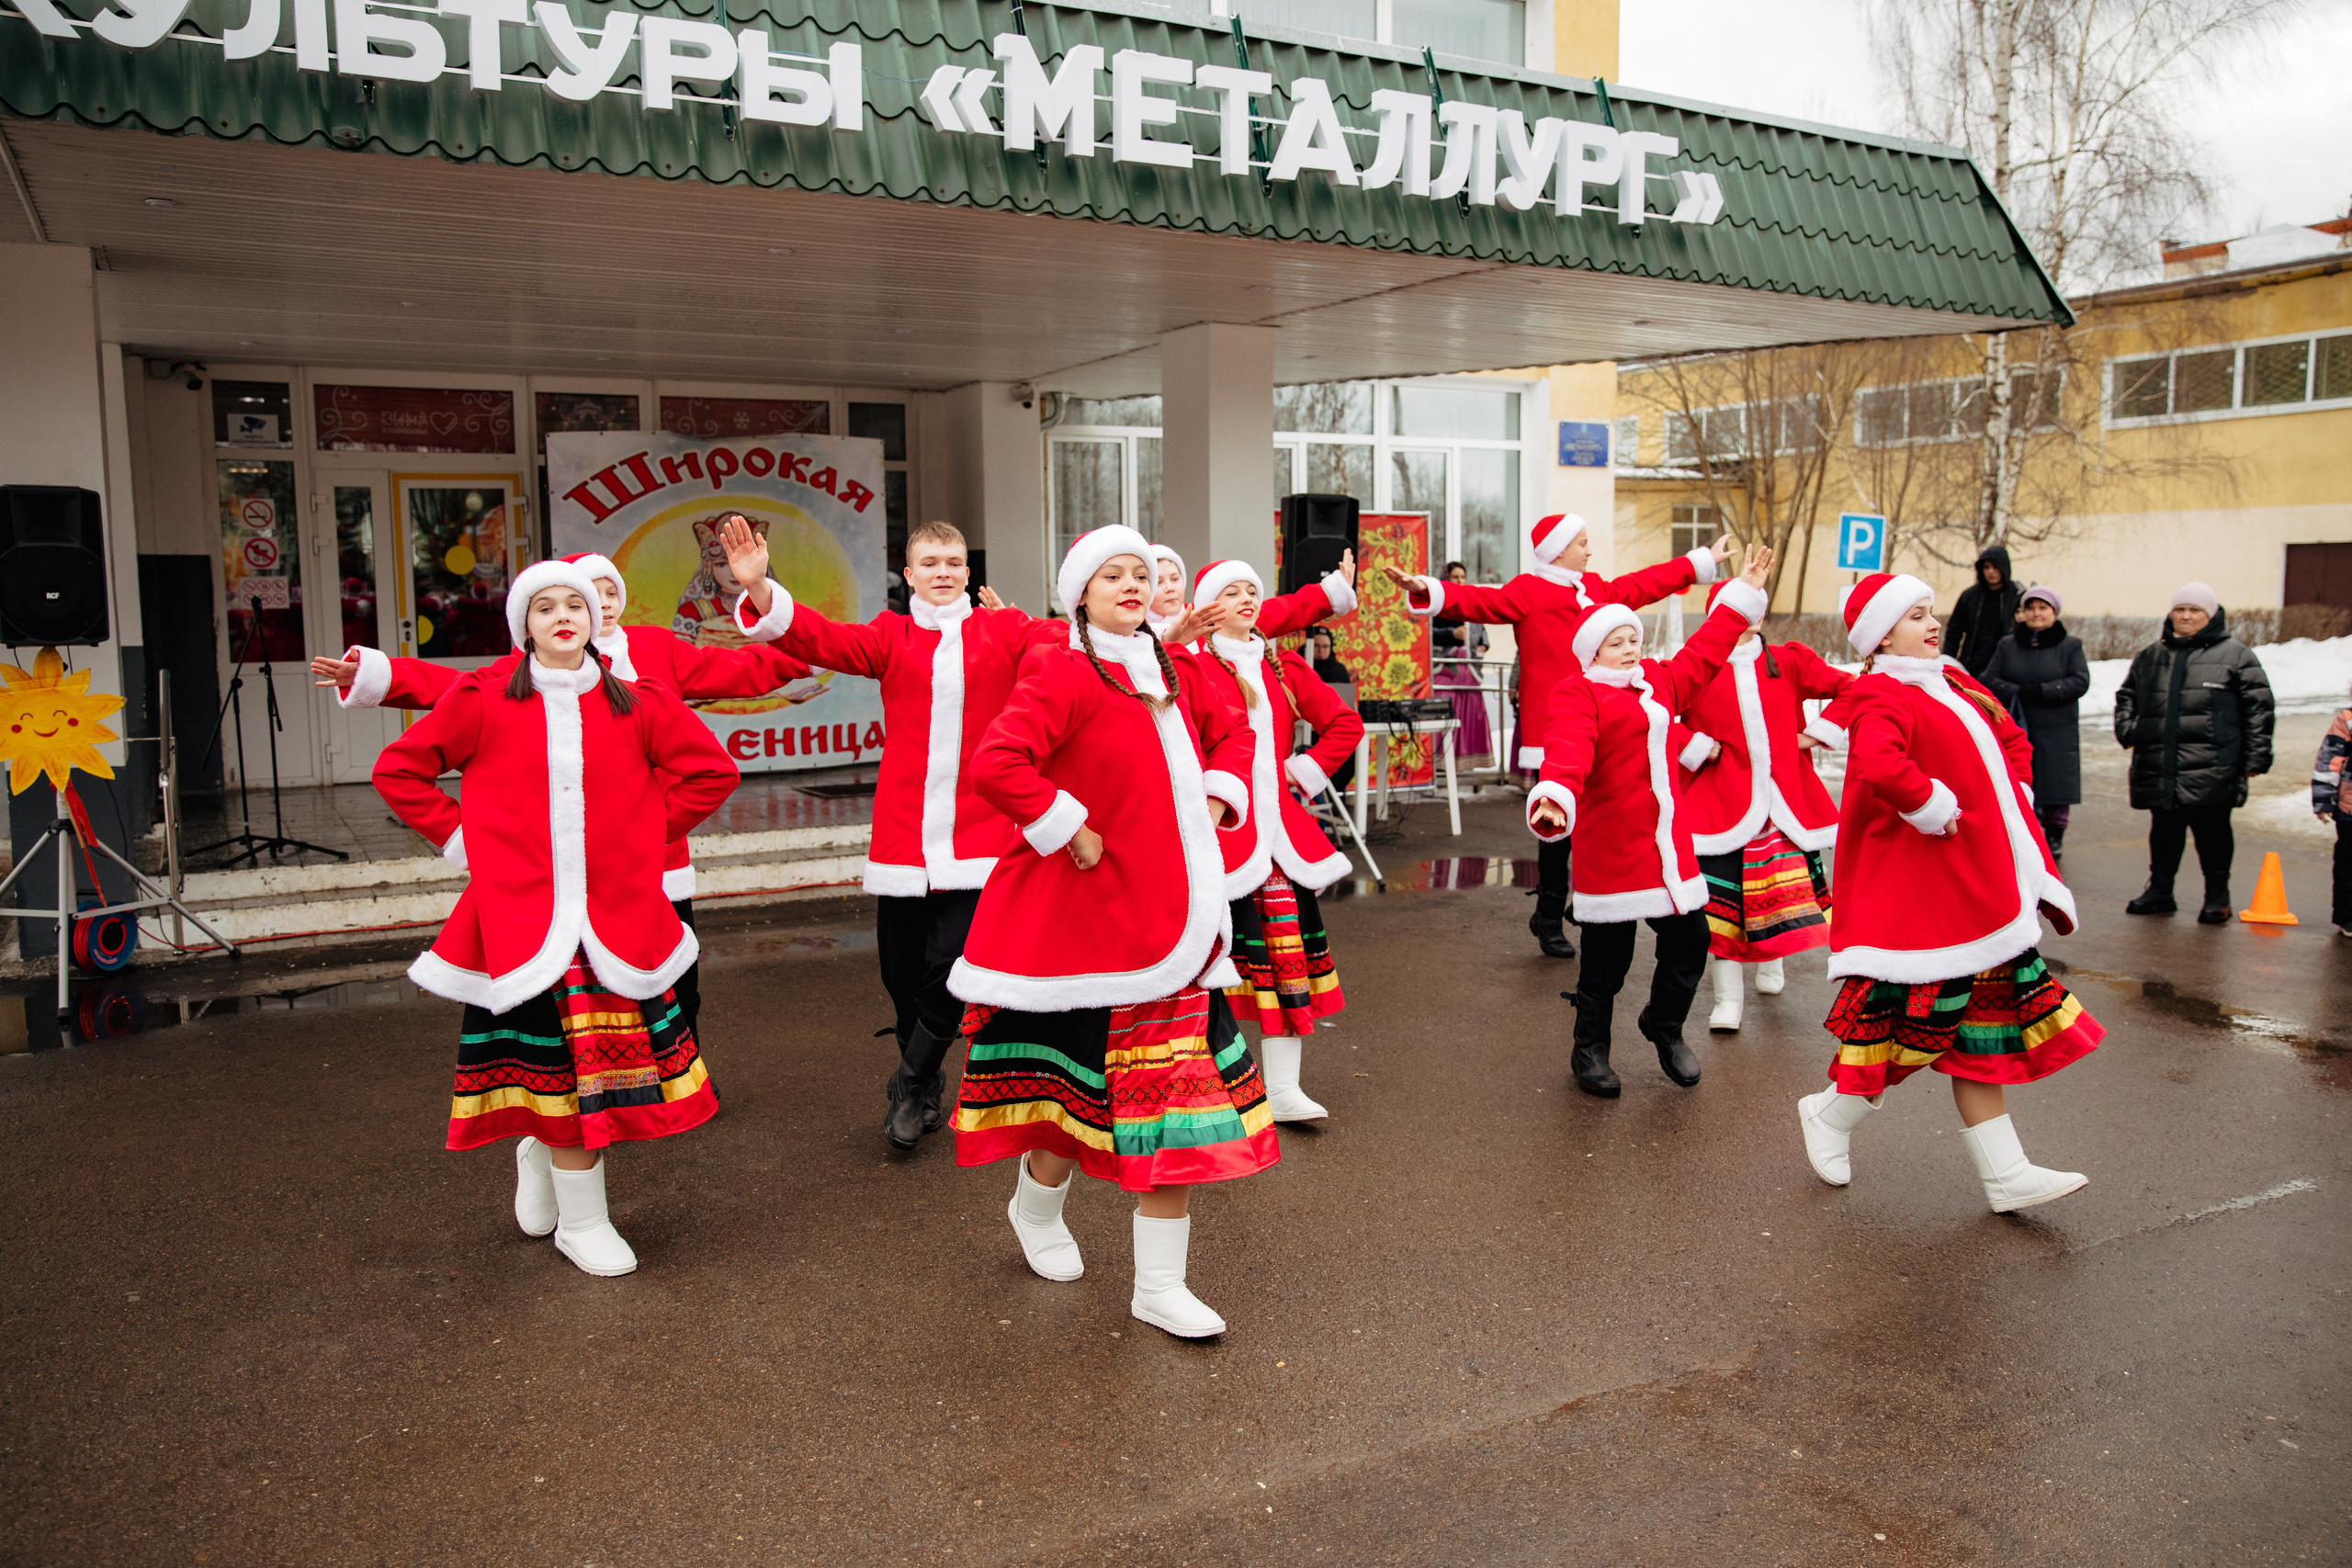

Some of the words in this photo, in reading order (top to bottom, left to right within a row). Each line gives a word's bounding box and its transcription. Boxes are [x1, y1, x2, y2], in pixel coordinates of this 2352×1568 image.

[920, 32, 1724, 226] «МЕТАЛЛУРГ»
[562, 447, 875, 525] Широкая
[1847, 520, 1875, 565] P
[46, 592, 60, 600] RCF
